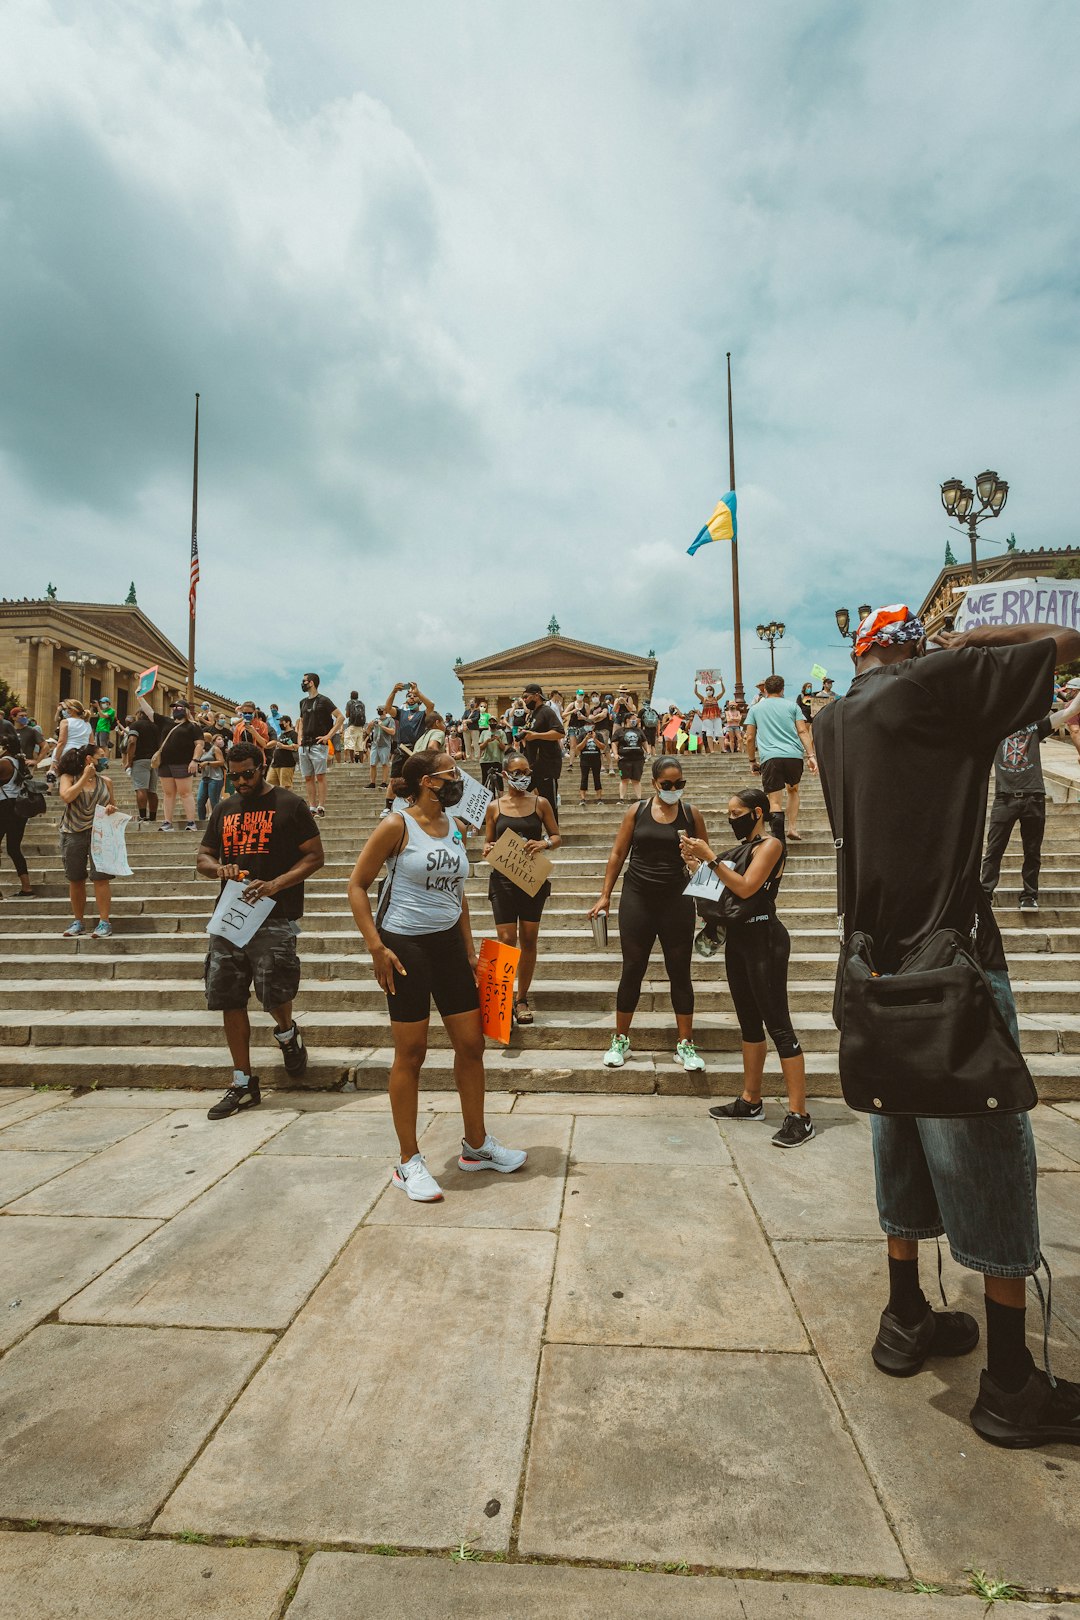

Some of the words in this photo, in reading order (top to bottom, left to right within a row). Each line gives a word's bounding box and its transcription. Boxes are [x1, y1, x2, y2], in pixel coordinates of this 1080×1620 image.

[967, 592, 997, 614] WE
[465, 793, 477, 814] Floyd
[470, 793, 482, 819] George
[475, 789, 490, 822] Justice
[222, 824, 238, 833] THIS
[259, 820, 273, 830] FOR
[223, 813, 241, 827] WE
[243, 810, 276, 825] BUILT
[426, 848, 461, 874] STAY
[495, 854, 537, 888] MATTER
[506, 850, 536, 873] LIVES
[425, 876, 464, 894] WOKE
[755, 914, 769, 922] PRO
[483, 958, 497, 1024] Violence
[493, 983, 500, 996] is
[498, 962, 514, 1021] Silence
